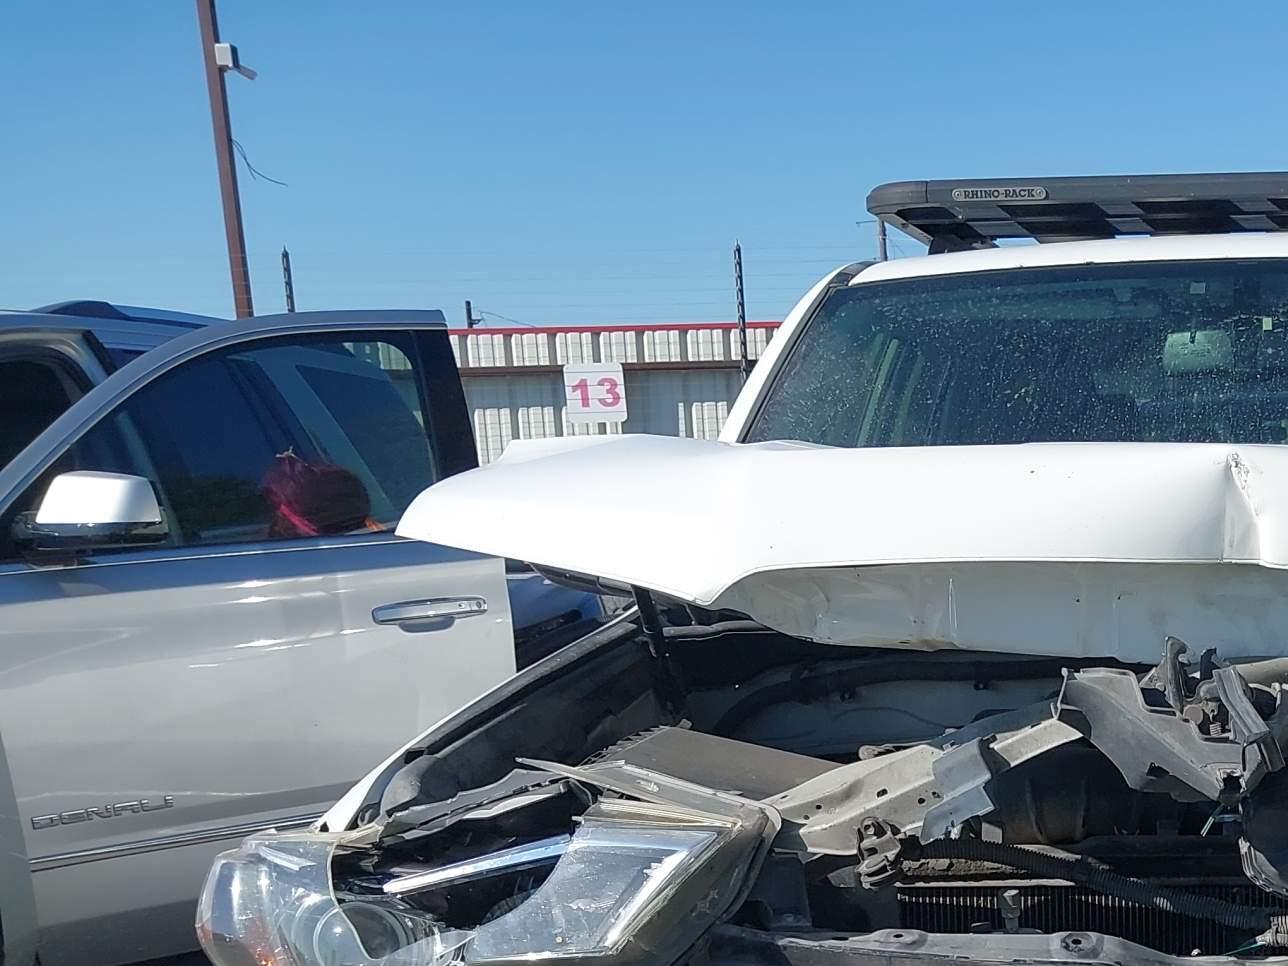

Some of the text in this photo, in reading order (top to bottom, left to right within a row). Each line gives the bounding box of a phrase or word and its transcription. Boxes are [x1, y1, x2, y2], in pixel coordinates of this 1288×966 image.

[963, 188, 1036, 199] RHINO-RACK
[571, 377, 620, 408] 13
[31, 795, 174, 830] DENALI
